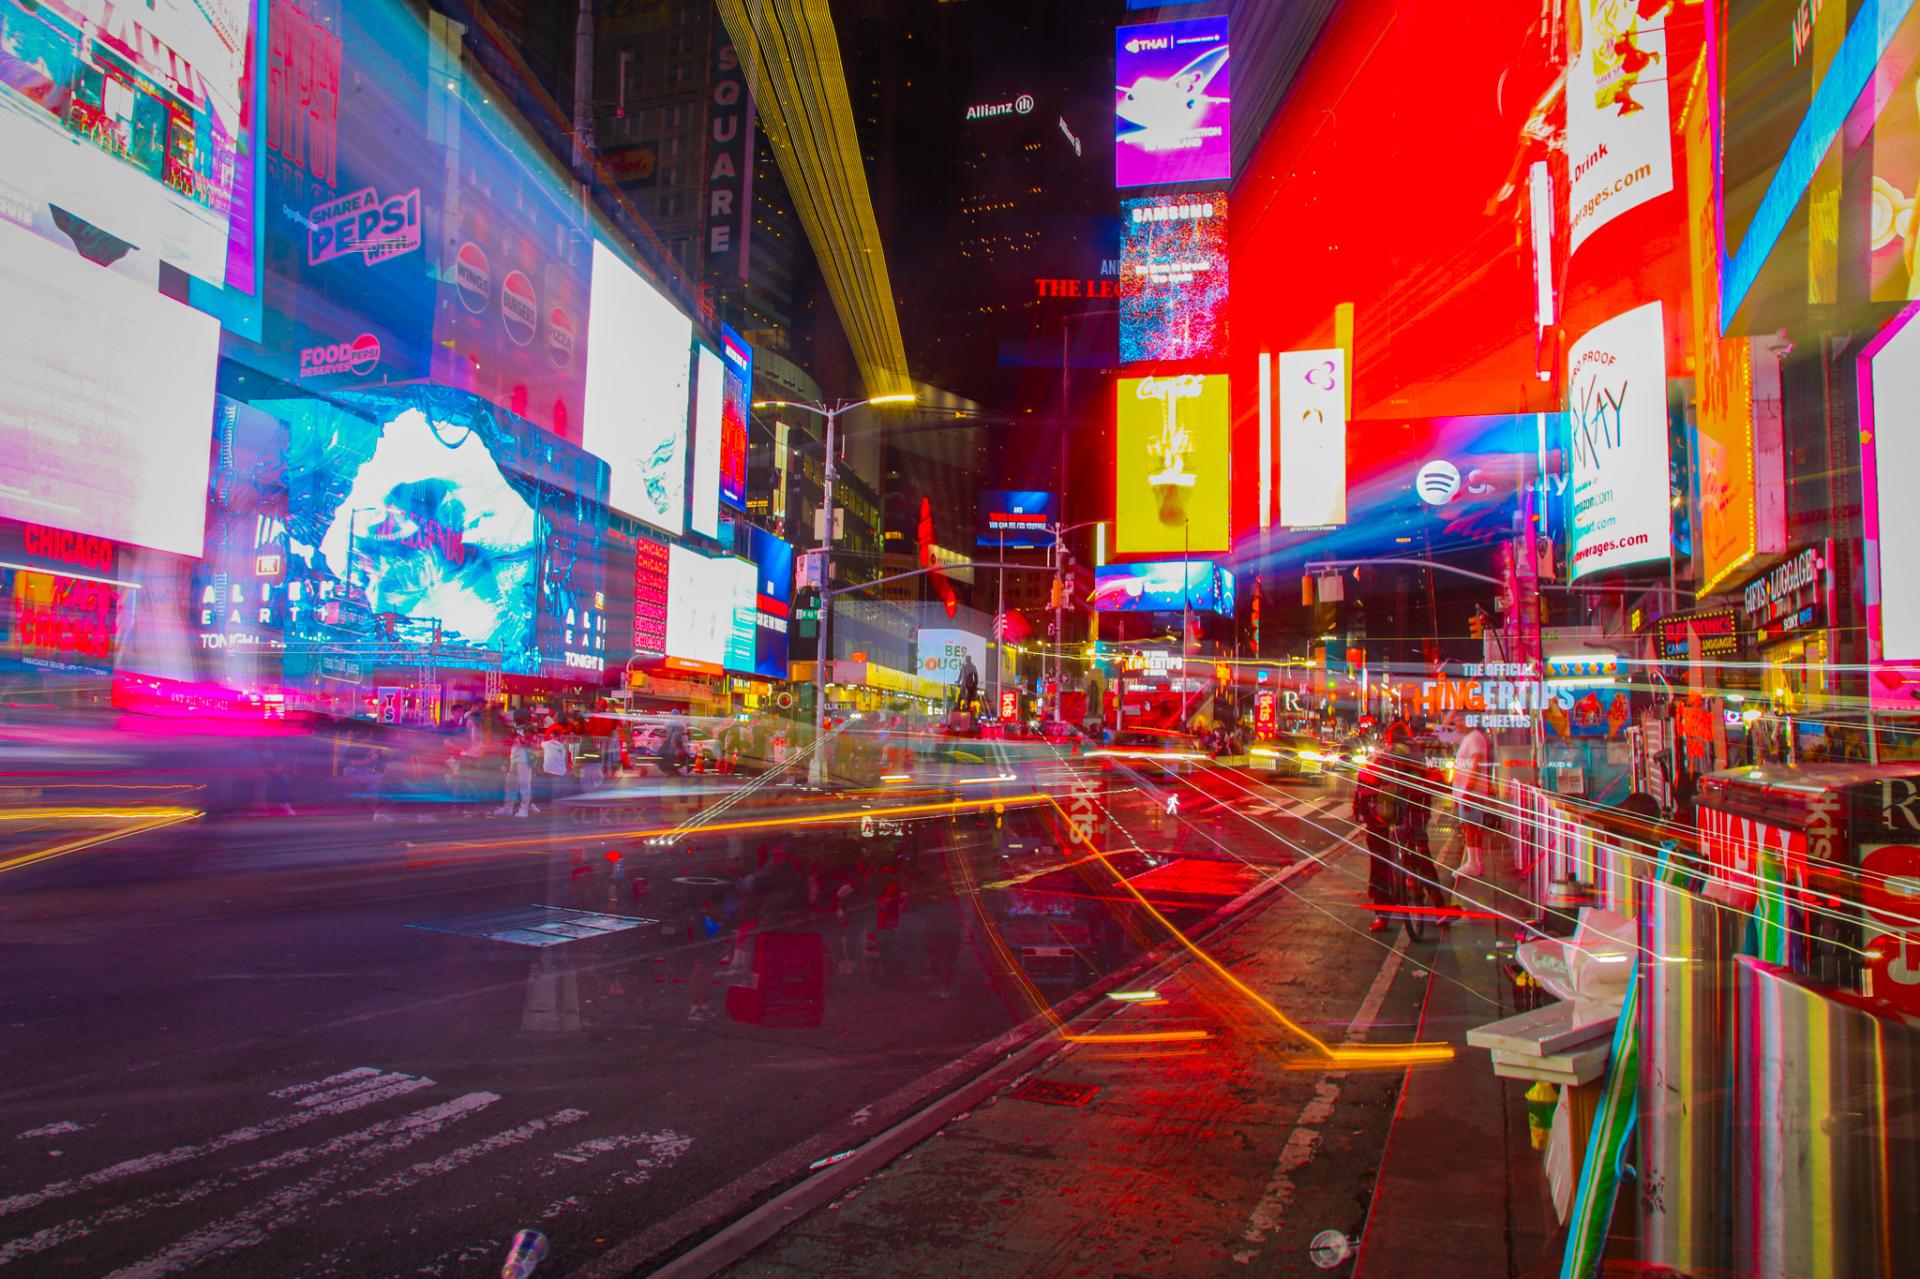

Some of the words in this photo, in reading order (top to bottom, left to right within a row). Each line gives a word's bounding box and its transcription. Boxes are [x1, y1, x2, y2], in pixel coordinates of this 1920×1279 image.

[1139, 37, 1168, 50] THAI
[966, 102, 1013, 120] Allianz
[710, 44, 740, 253] SQUARE
[1575, 143, 1608, 182] Drink
[311, 196, 361, 223] SHARE
[363, 191, 375, 206] A
[1132, 203, 1213, 222] SAMSUNG
[311, 194, 416, 260] PEPSI
[457, 262, 488, 293] WINGS
[1034, 279, 1082, 297] THE
[503, 290, 535, 325] BURGERS
[301, 344, 352, 368] FOOD
[352, 347, 379, 360] PEPSI
[1583, 350, 1616, 366] PROOF
[24, 523, 113, 573] CHICAGO
[637, 537, 669, 561] CHICAGO
[637, 554, 668, 576] CHICAGO
[1771, 548, 1813, 601] LUGGAGE
[1665, 615, 1731, 641] ELECONICS
[1783, 613, 1798, 632] SONY
[1702, 636, 1734, 650] UGGAGE
[1462, 663, 1479, 676] THE
[1485, 663, 1536, 677] OFFICIAL
[1003, 693, 1015, 718] tkts
[1259, 696, 1271, 722] tkts
[1284, 691, 1304, 711] R
[1465, 715, 1480, 728] OF
[1482, 714, 1531, 728] CHEETOS
[1424, 756, 1476, 769] WEDSDAY
[1069, 781, 1101, 844] tkts
[1808, 792, 1841, 860] tkts
